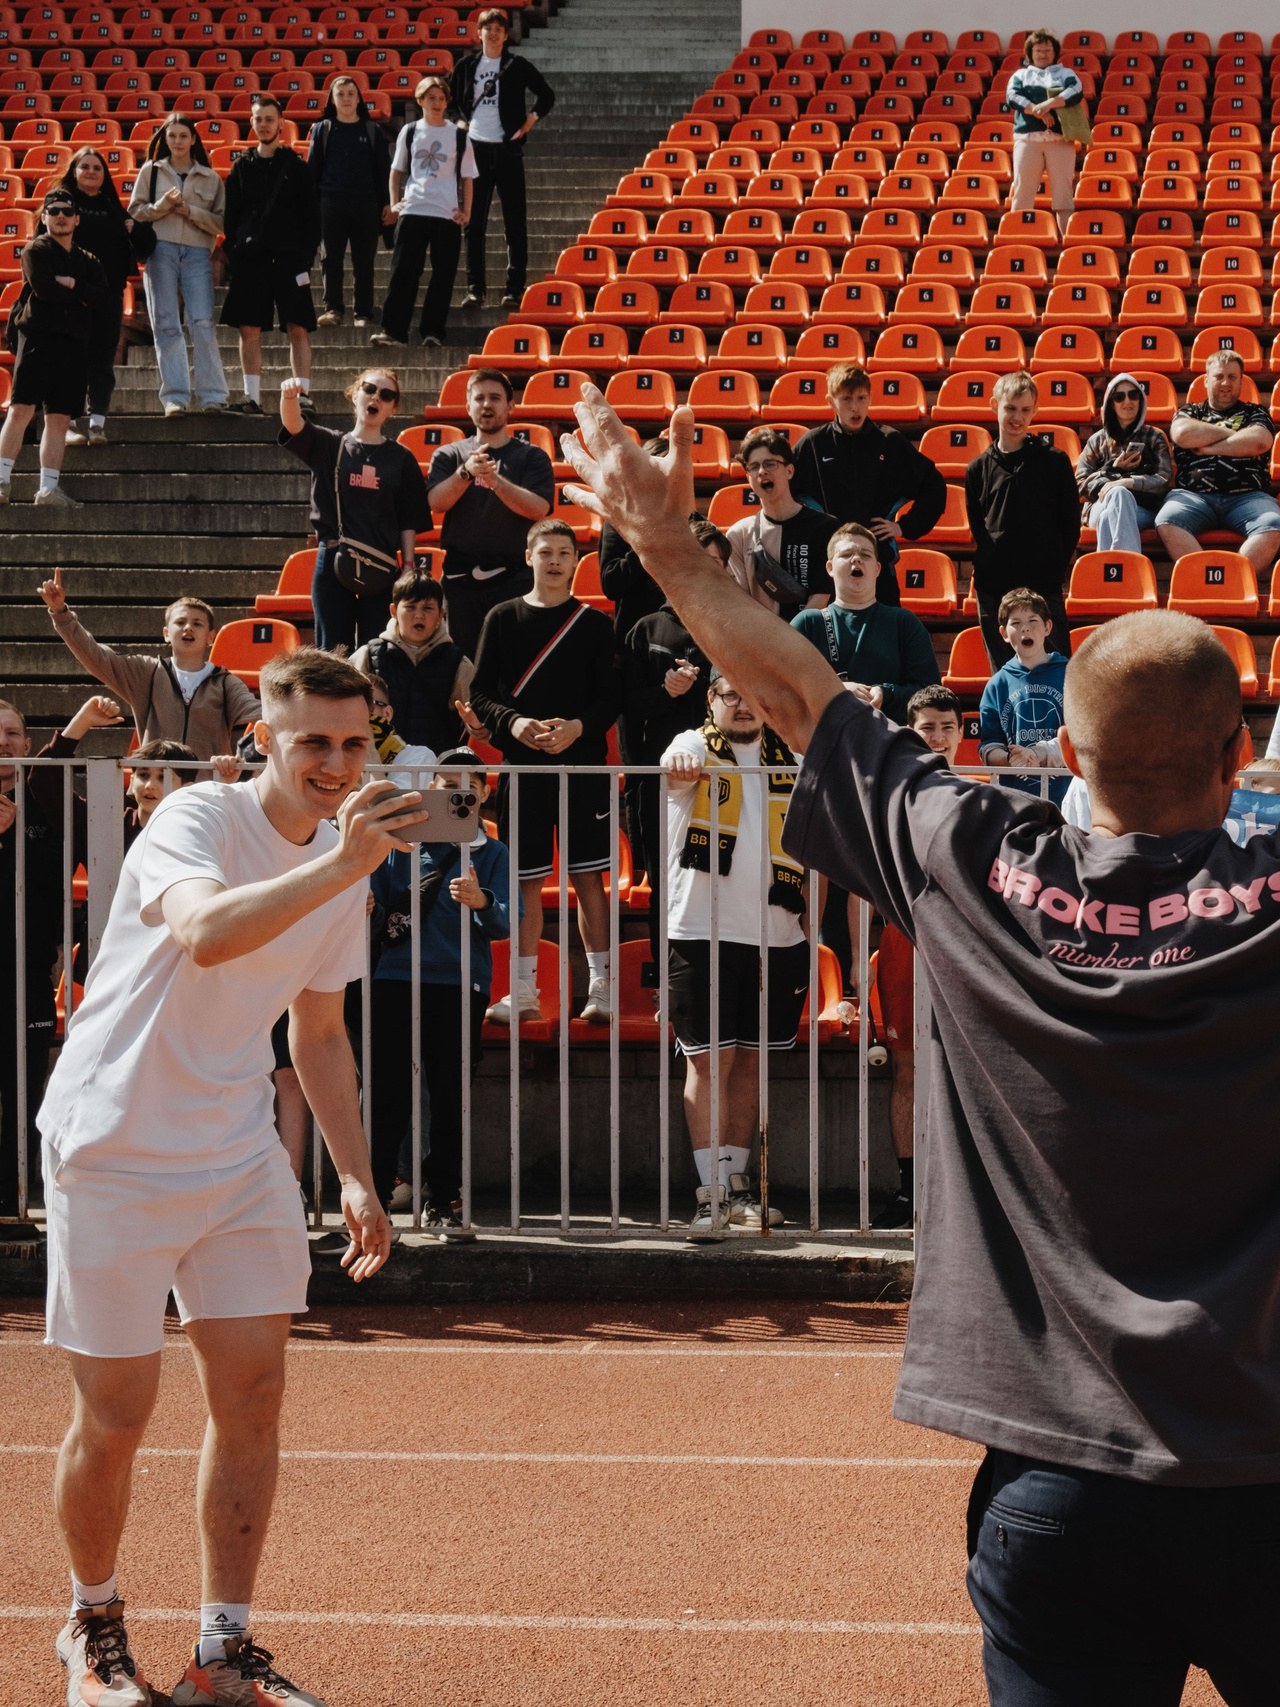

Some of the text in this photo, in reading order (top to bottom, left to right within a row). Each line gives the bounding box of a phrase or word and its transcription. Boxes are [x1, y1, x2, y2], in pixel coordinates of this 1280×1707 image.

[210, 124, 220, 132] 36
[110, 153, 119, 161] 35
[870, 261, 876, 270] 5
[1014, 261, 1020, 270] 7
[1158, 262, 1164, 271] 9
[1227, 260, 1237, 268] 10
[700, 289, 707, 298] 3
[851, 288, 857, 298] 5
[923, 291, 929, 300] 6
[1076, 290, 1082, 298] 8
[1151, 293, 1157, 302] 9
[626, 295, 632, 305] 2
[775, 299, 781, 308] 4
[1000, 298, 1006, 307] 7
[1224, 297, 1234, 306] 10
[593, 336, 599, 345] 2
[673, 331, 680, 341] 3
[751, 334, 758, 343] 4
[828, 336, 834, 346] 5
[906, 337, 913, 346] 6
[990, 339, 996, 348] 7
[1065, 336, 1072, 346] 8
[1146, 338, 1152, 348] 9
[558, 376, 565, 386] 2
[641, 377, 648, 387] 3
[724, 379, 730, 388] 4
[804, 382, 811, 392] 5
[888, 383, 895, 393] 6
[972, 385, 979, 394] 7
[1055, 384, 1062, 393] 8
[519, 432, 526, 442] 2
[955, 434, 962, 444] 7
[1042, 435, 1049, 444] 8
[748, 492, 756, 502] 5
[419, 556, 427, 568] 2
[1110, 567, 1117, 578] 9
[1209, 570, 1222, 581] 10
[912, 574, 919, 585] 7
[970, 722, 979, 735] 8
[690, 833, 728, 849] BBC
[987, 857, 1140, 936] BROKE
[1049, 942, 1195, 968] number one
